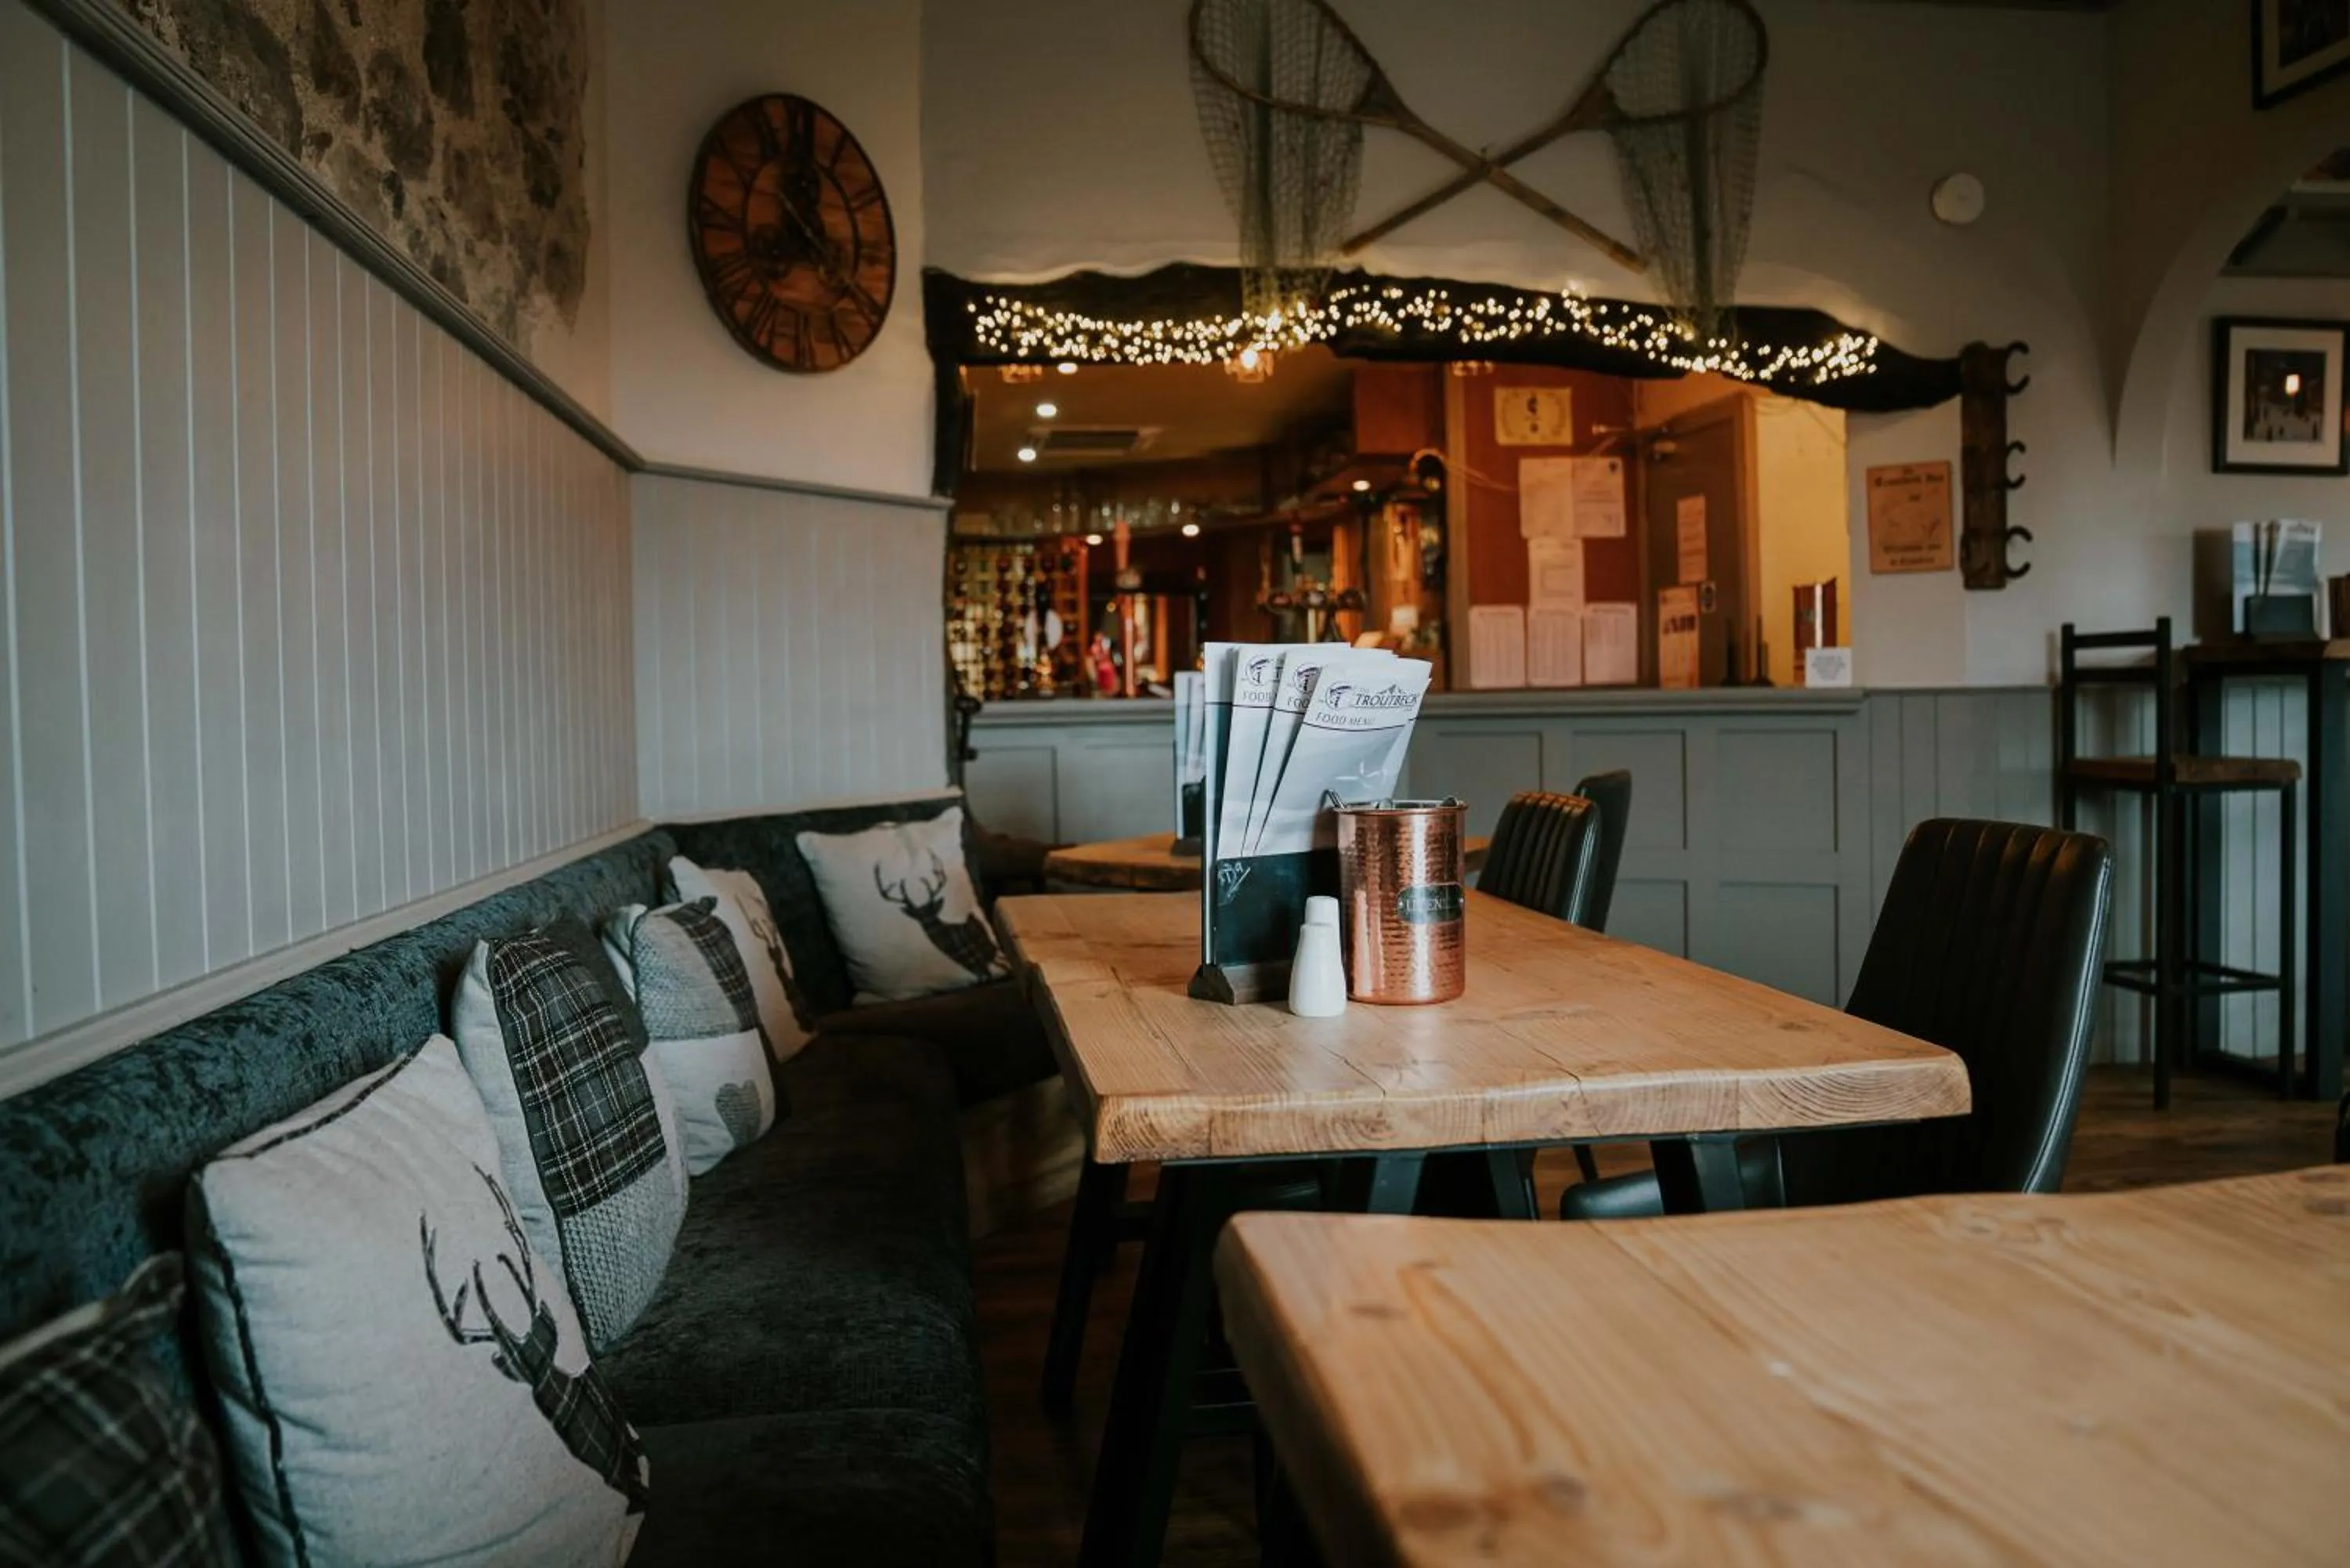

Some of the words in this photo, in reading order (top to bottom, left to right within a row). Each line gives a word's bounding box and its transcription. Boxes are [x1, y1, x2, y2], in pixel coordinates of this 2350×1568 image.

[1287, 695, 1311, 709] FOO
[1355, 692, 1419, 706] TROUTBECK
[1315, 711, 1347, 725] FOOD
